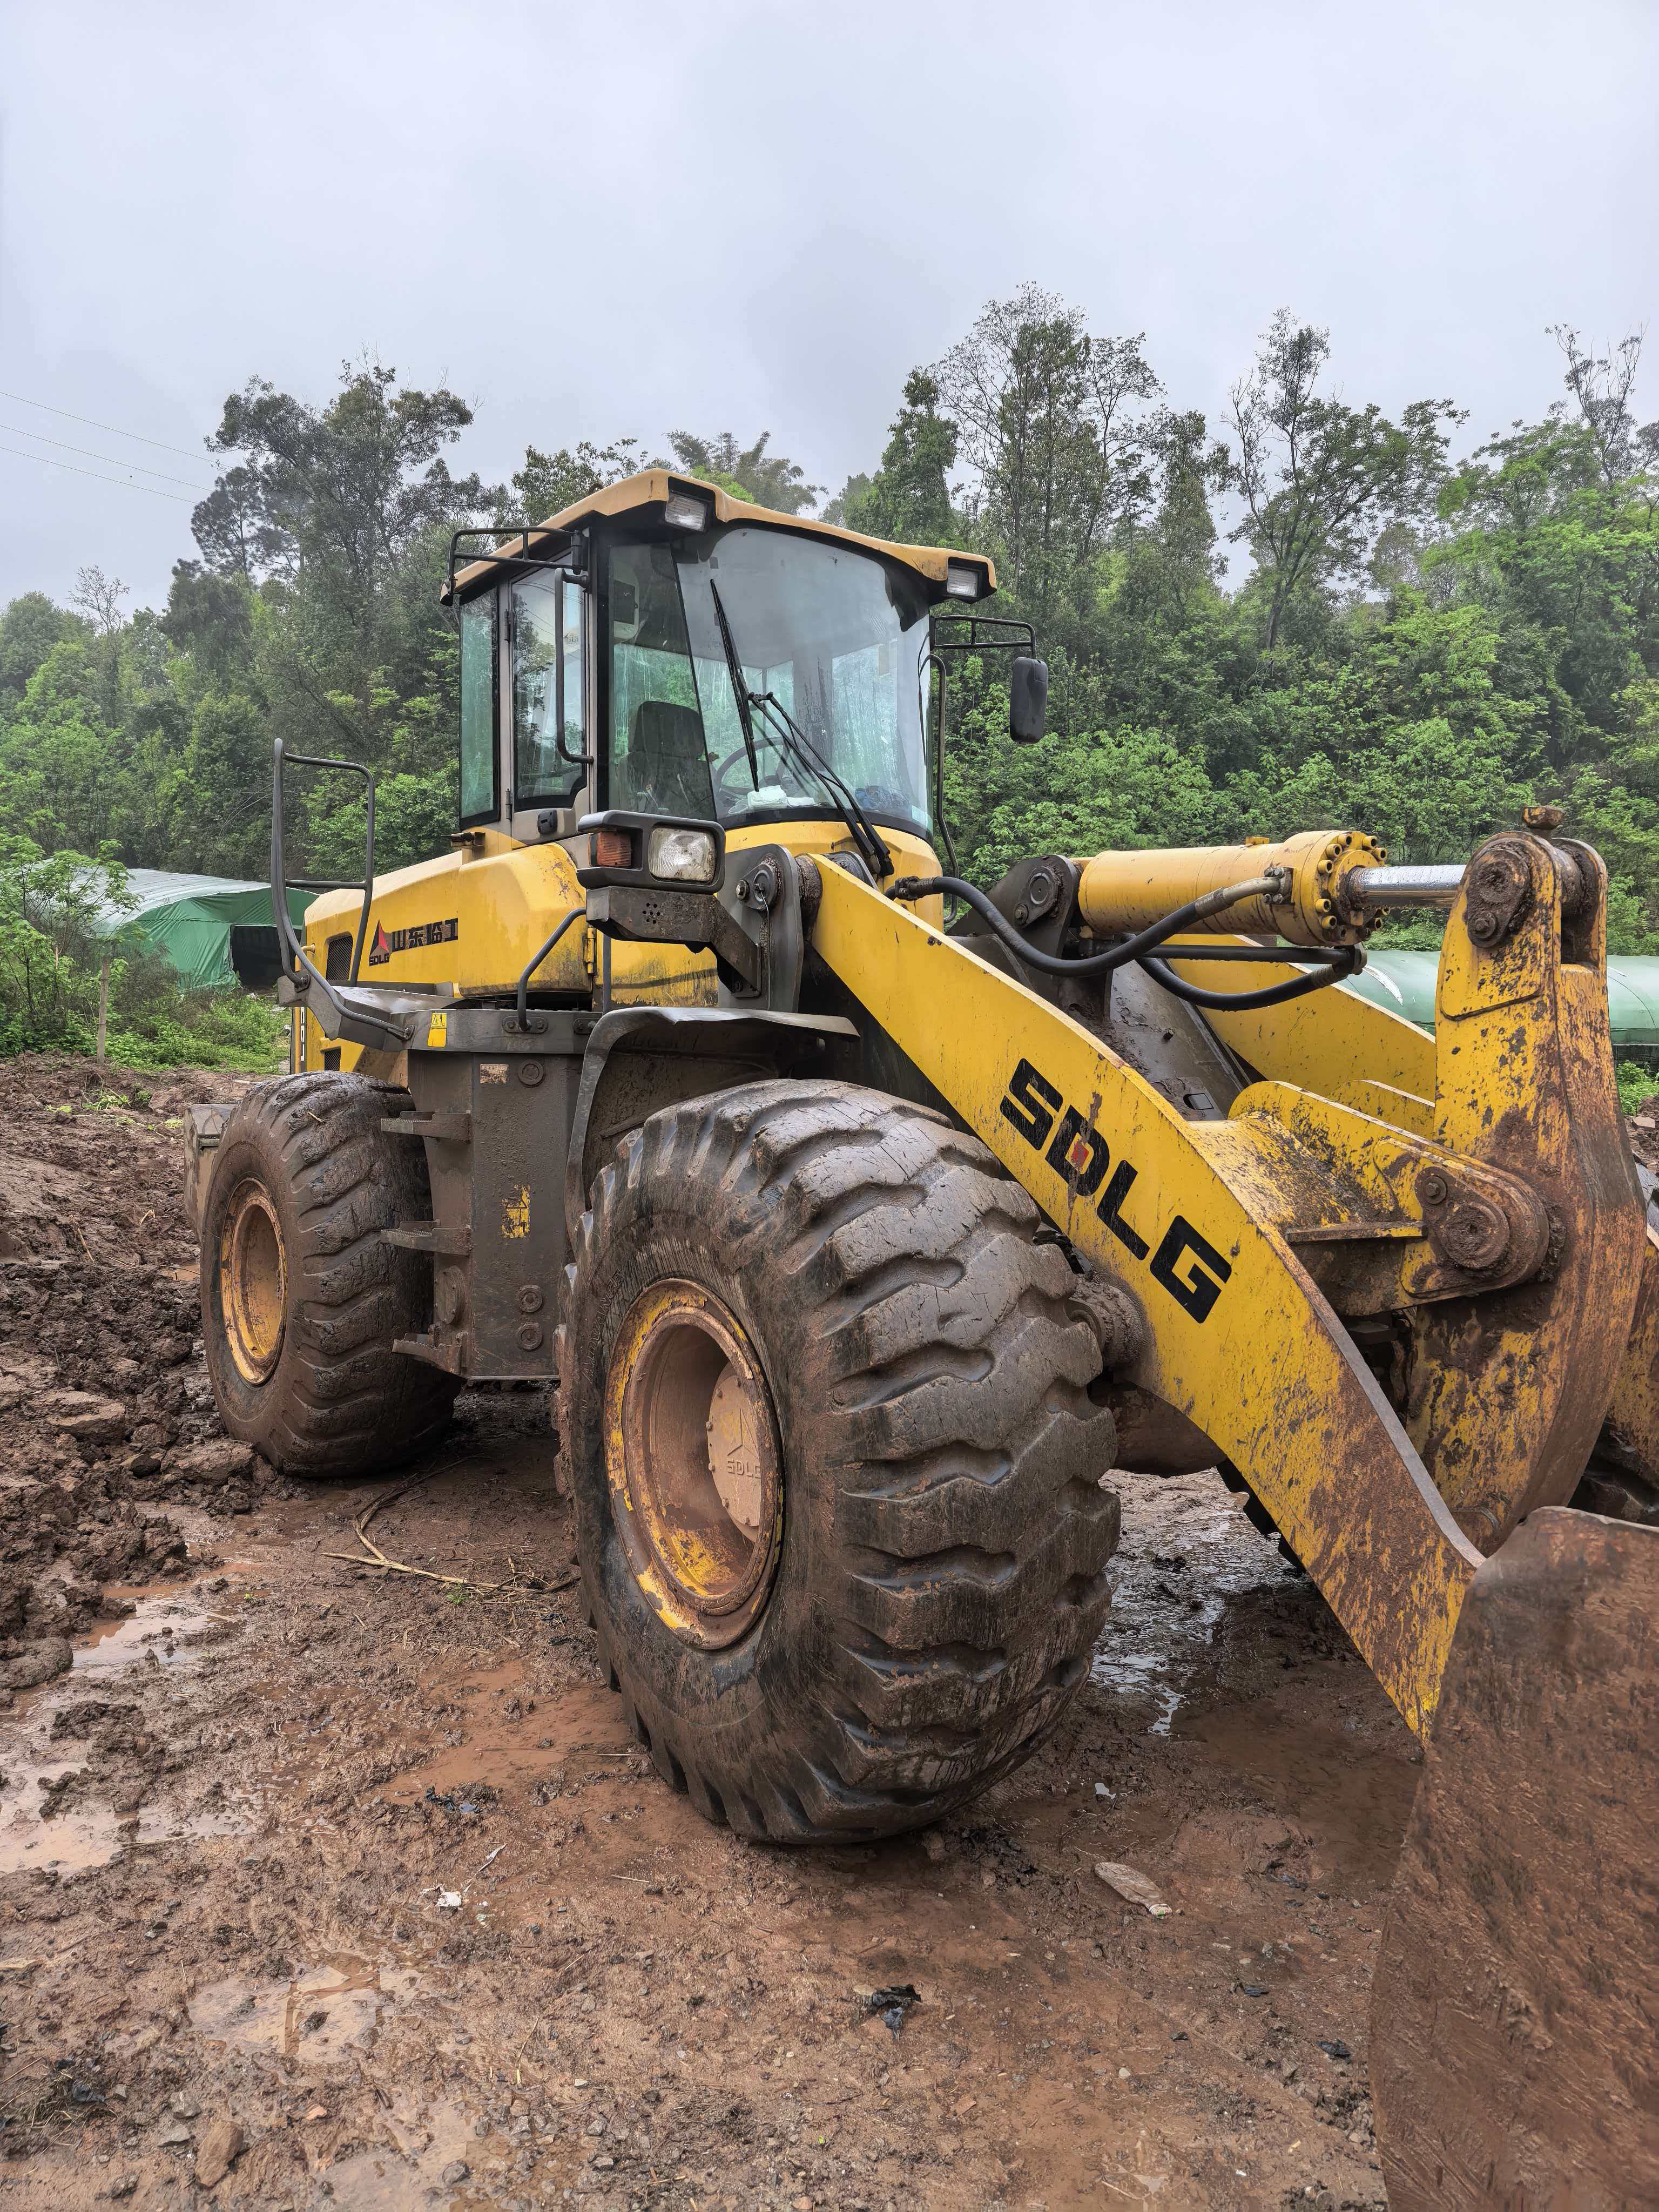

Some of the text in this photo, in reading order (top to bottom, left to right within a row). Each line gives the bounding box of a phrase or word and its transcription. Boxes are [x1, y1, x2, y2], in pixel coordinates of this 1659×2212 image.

[392, 918, 458, 952] 山东临工
[369, 953, 389, 966] SDLG
[1000, 1058, 1232, 1324] SDLG
